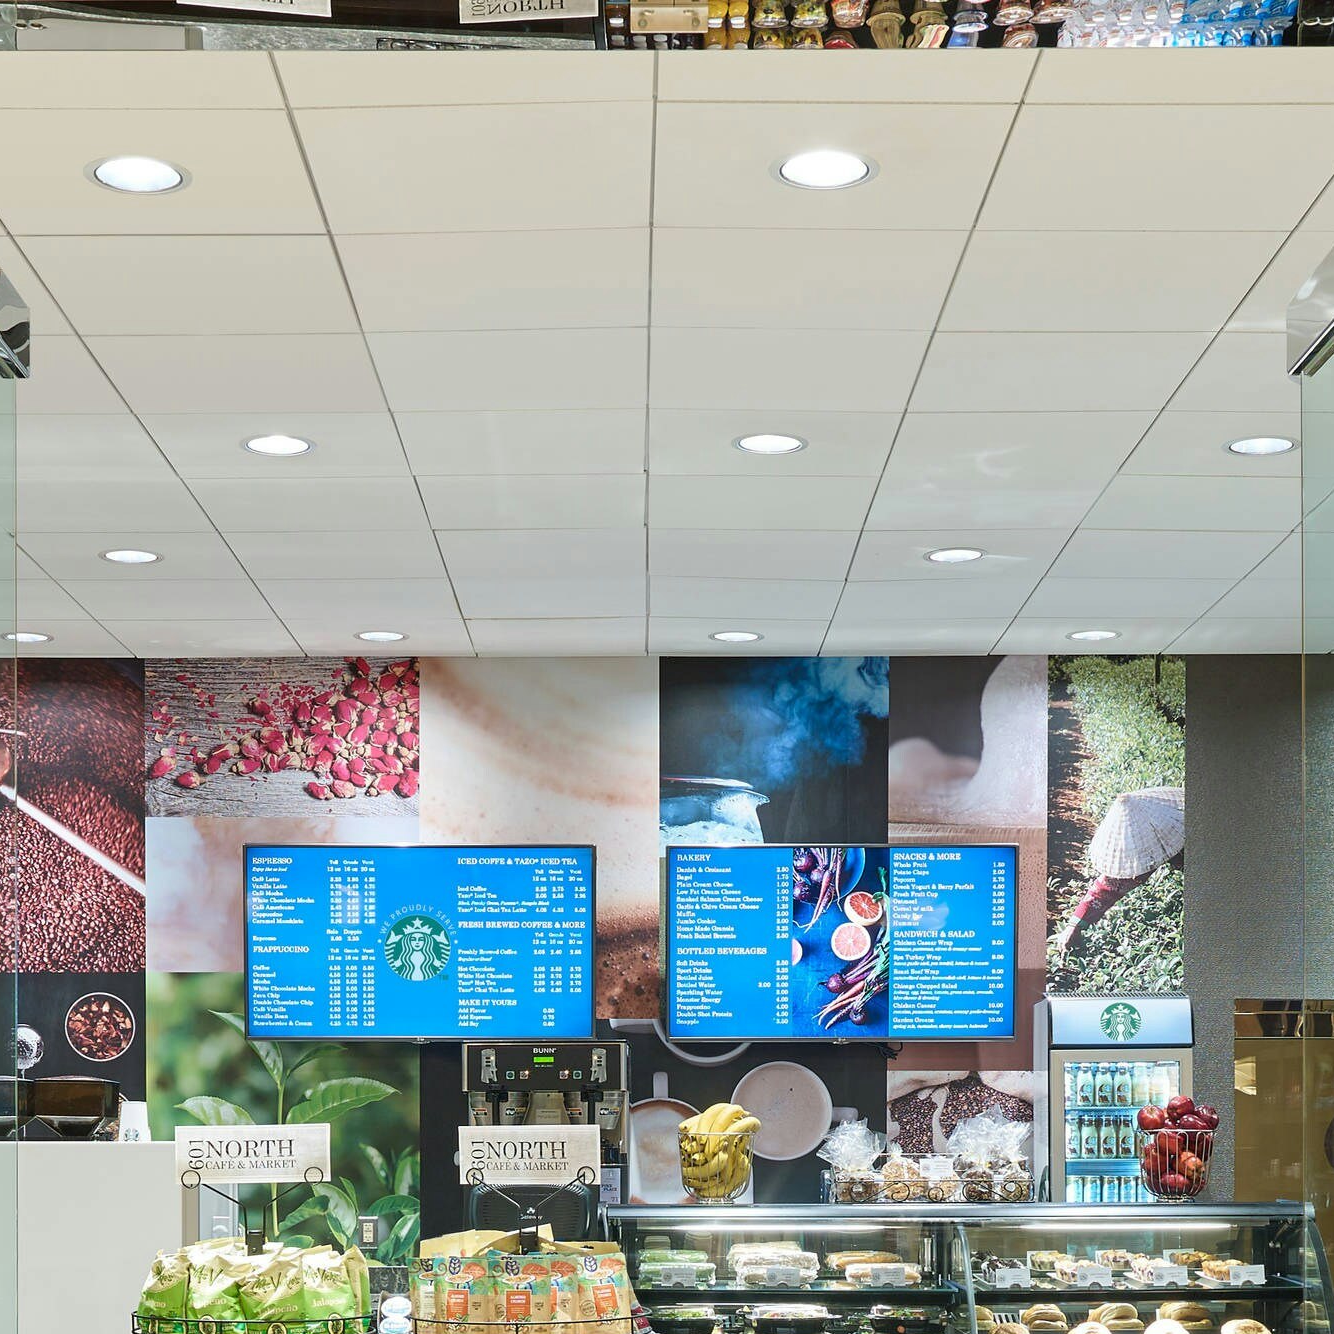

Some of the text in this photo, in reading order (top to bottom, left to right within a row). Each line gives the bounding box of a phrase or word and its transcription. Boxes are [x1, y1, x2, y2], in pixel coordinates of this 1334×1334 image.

[380, 904, 457, 935] WE PROUDLY SERVE
[894, 930, 938, 938] SANDWICH
[188, 1140, 204, 1170] 601
[206, 1139, 295, 1159] NORTH
[487, 1141, 567, 1159] NORTH
[238, 1162, 246, 1170] &
[249, 1160, 296, 1169] MARKET
[514, 1162, 521, 1170] &
[524, 1161, 569, 1170] MARKET
